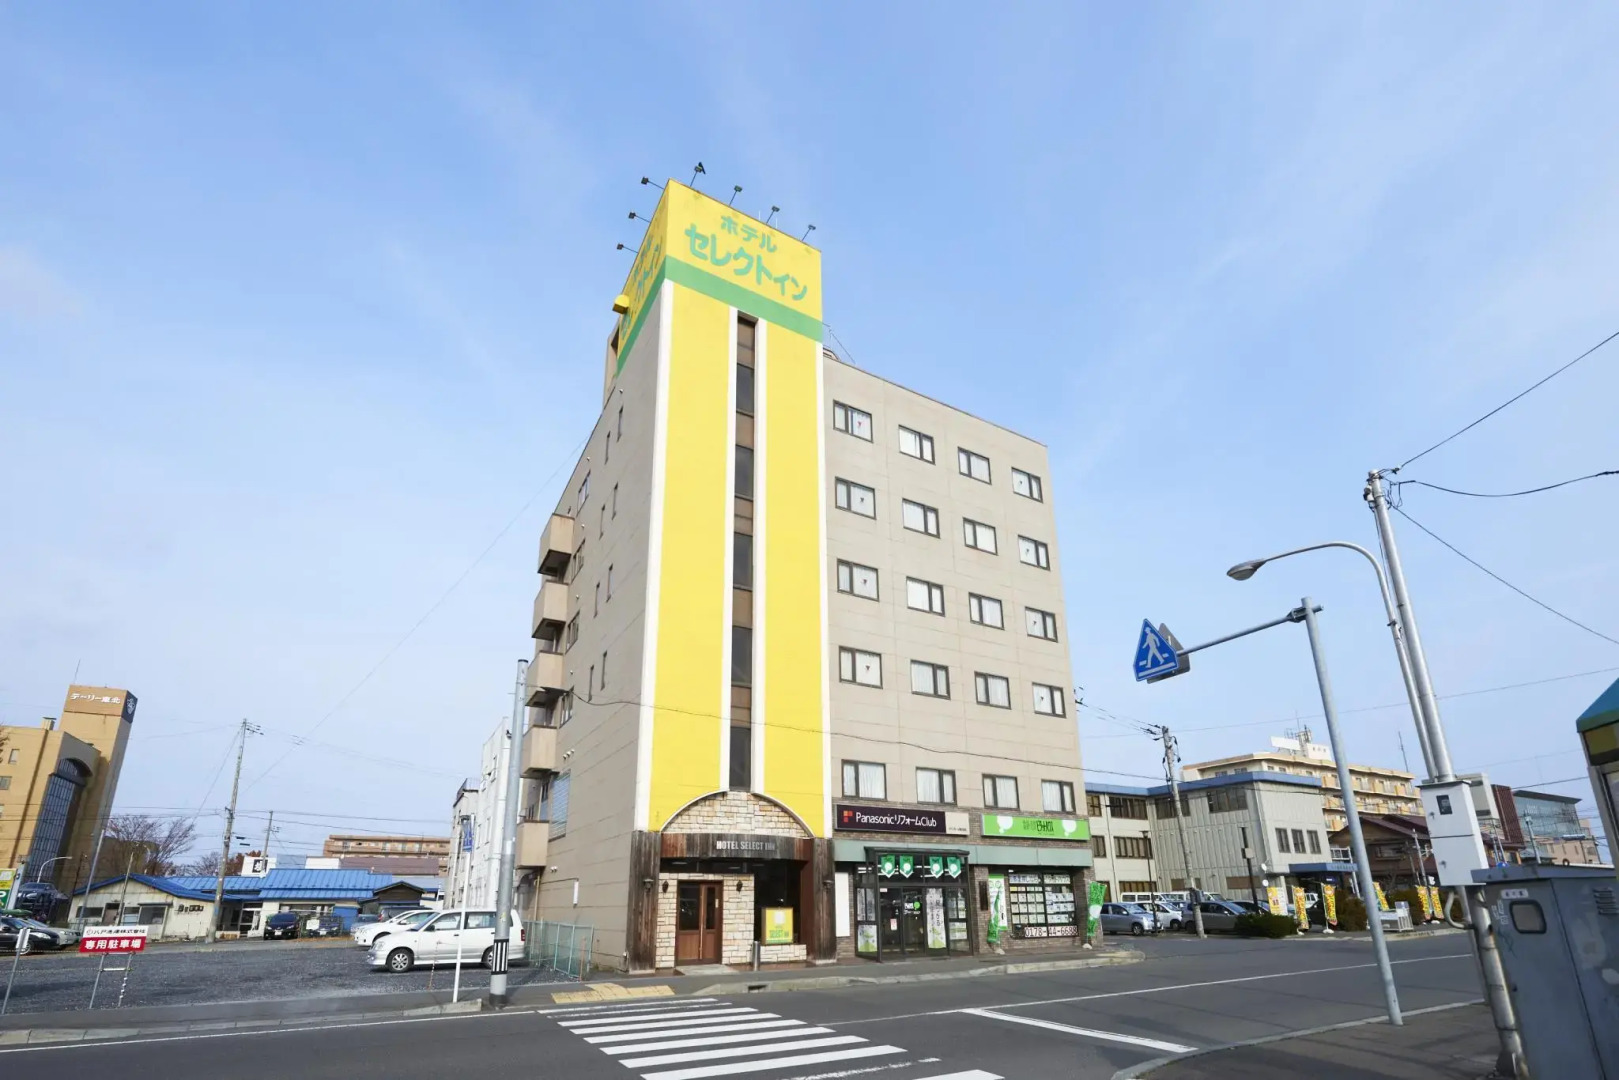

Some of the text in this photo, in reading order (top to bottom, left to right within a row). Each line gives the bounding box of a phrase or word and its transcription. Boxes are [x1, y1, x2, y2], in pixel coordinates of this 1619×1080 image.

[720, 215, 777, 253] ホテル
[684, 223, 808, 301] セレクトイン
[716, 840, 739, 850] HOTEL
[740, 841, 764, 850] SELECT
[85, 938, 142, 949] 専用駐車場
